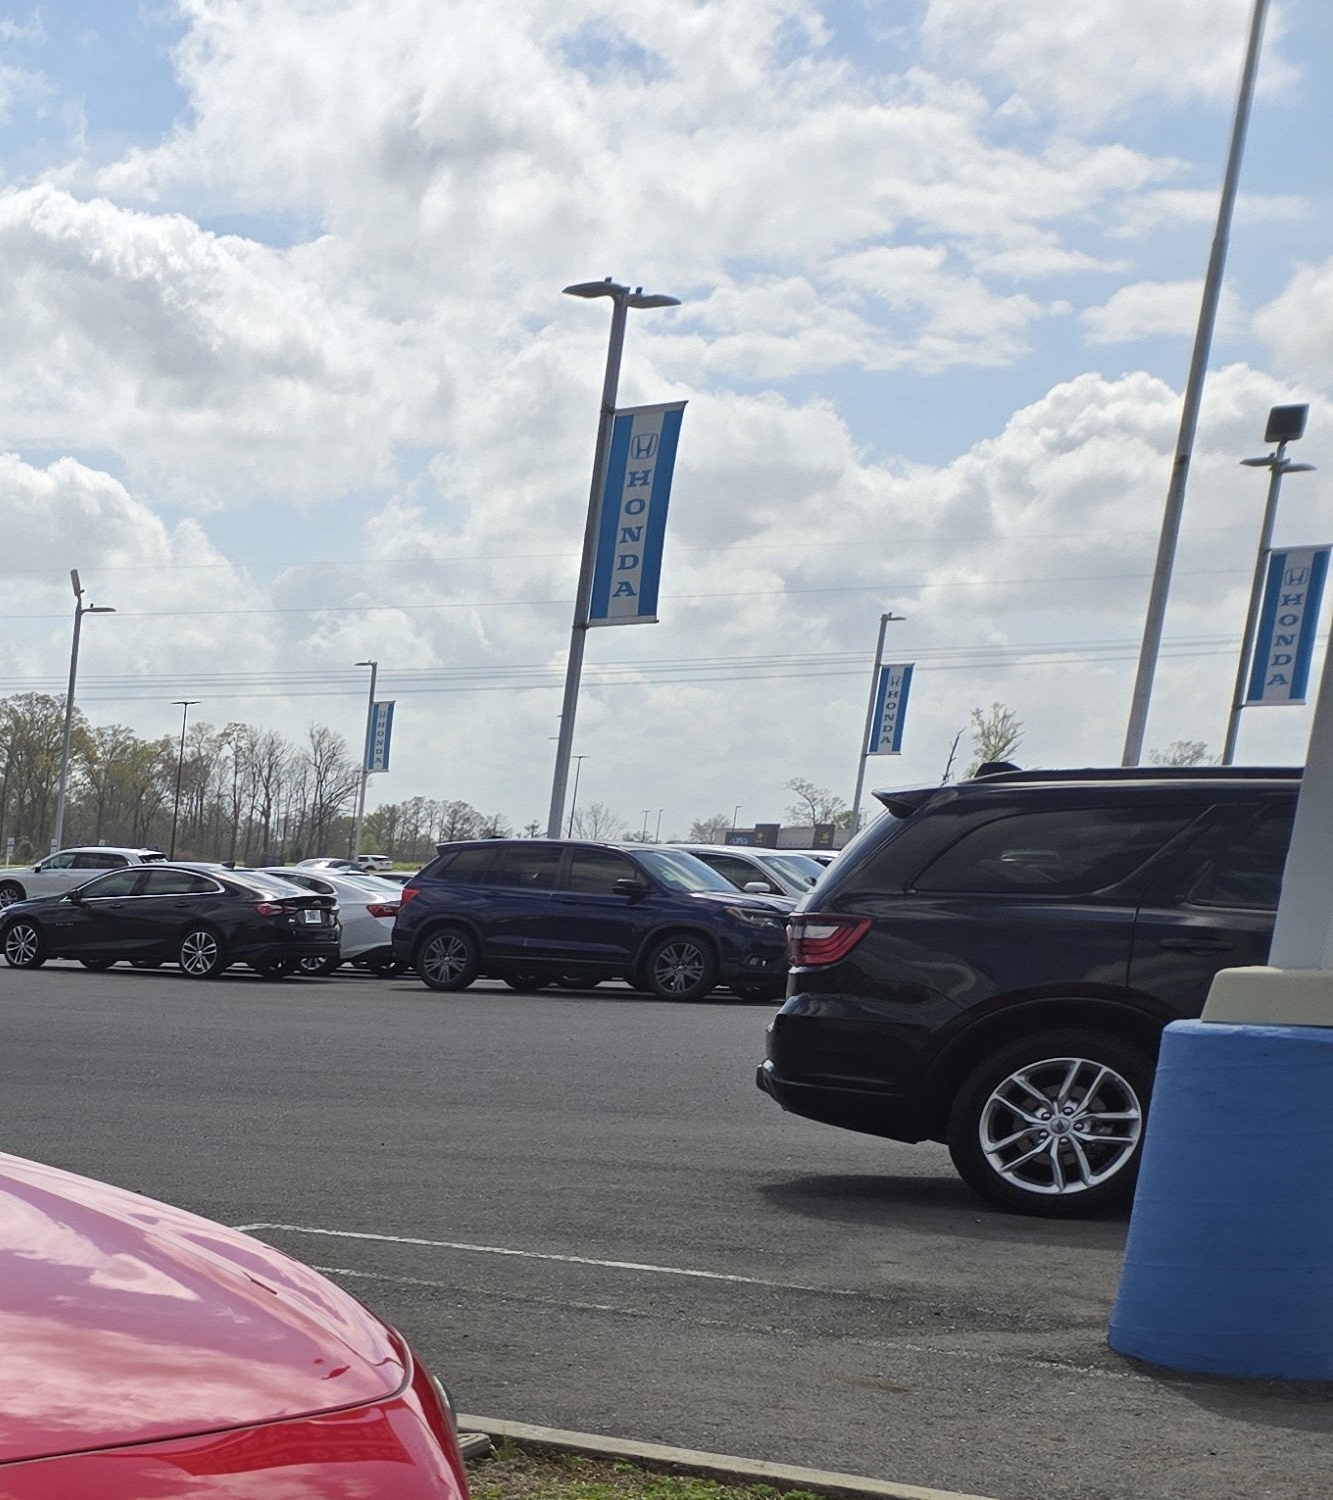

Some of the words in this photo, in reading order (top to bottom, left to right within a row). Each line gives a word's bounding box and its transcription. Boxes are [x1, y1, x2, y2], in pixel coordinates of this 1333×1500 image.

[612, 469, 652, 597] HONDA
[1267, 593, 1304, 686] HONDA
[374, 721, 385, 763] HONDA
[880, 690, 898, 743] HONDA
